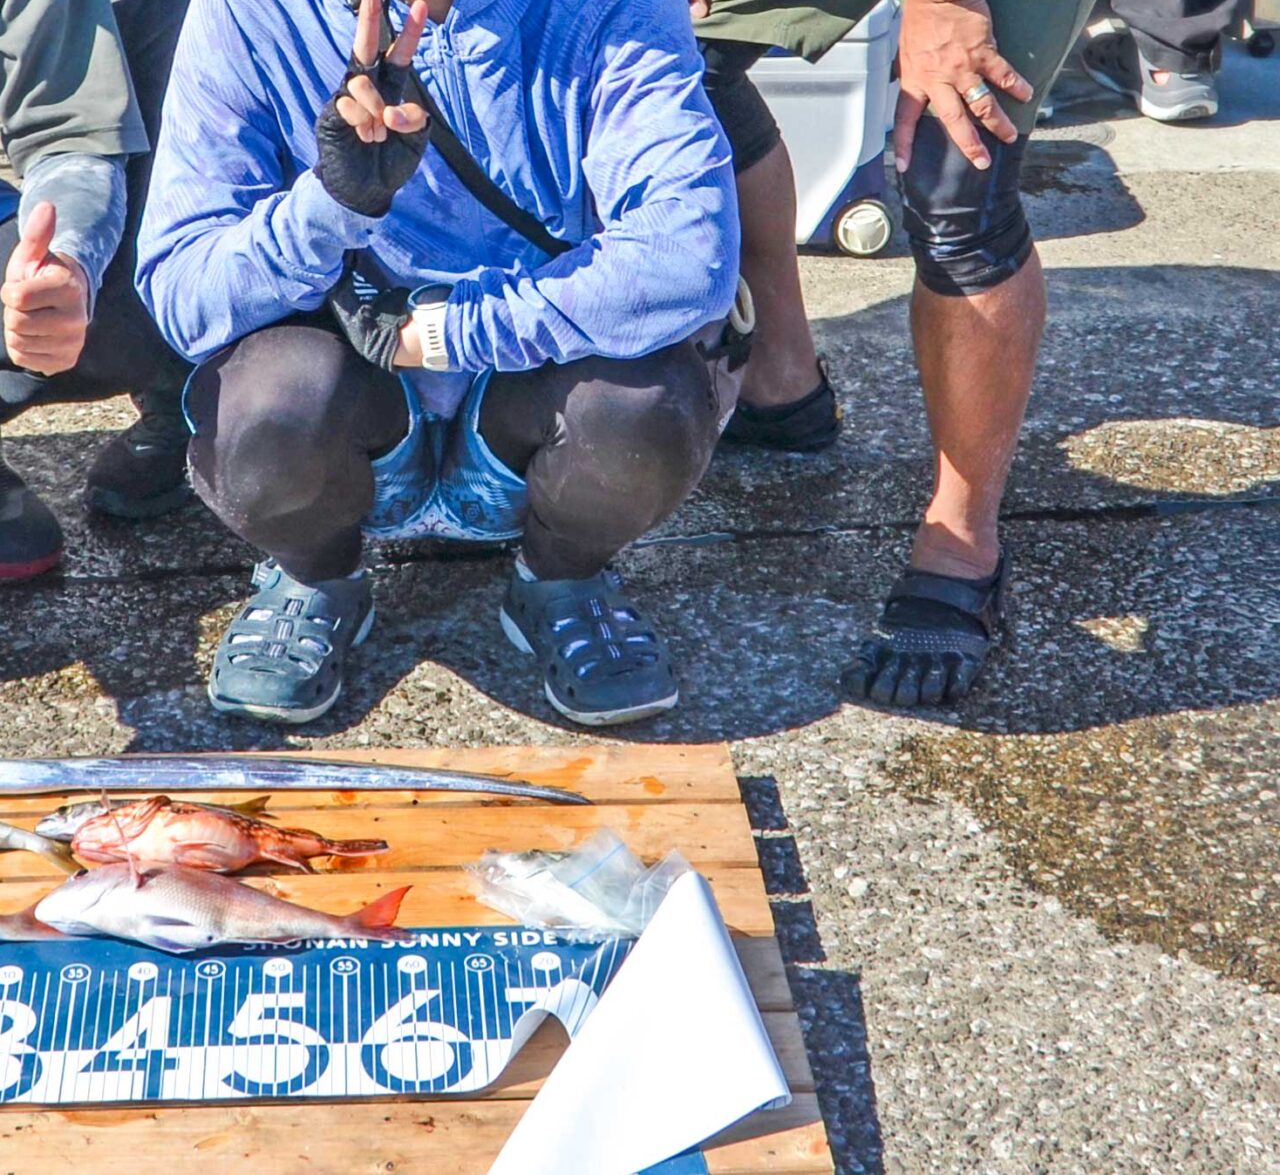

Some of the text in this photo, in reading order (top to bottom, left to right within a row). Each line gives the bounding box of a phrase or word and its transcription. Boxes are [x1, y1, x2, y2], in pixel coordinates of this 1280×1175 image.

[381, 931, 483, 950] SUNNY
[493, 930, 558, 947] SIDE
[67, 968, 84, 979] 35
[202, 963, 220, 975] 45
[271, 962, 287, 972] 50
[337, 961, 354, 971] 55
[404, 959, 421, 969] 60
[471, 957, 488, 968] 65
[78, 995, 181, 1100] 4
[220, 991, 331, 1096] 5
[360, 988, 474, 1094] 6
